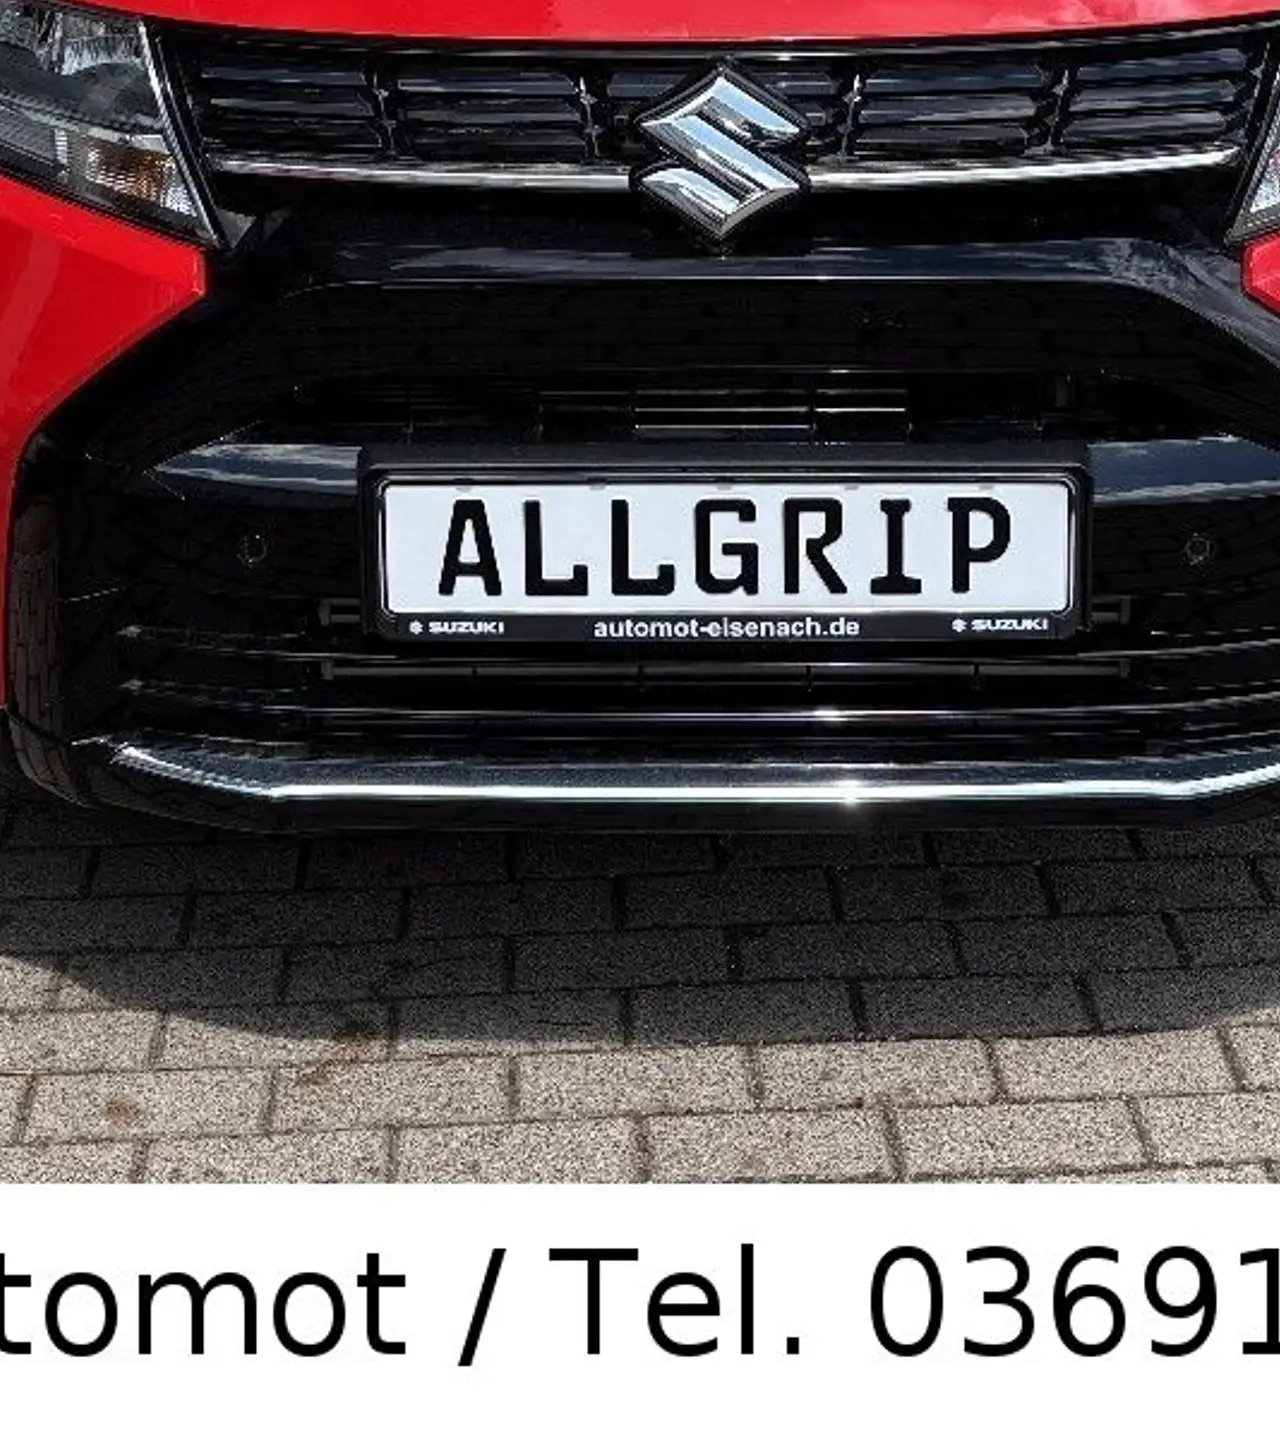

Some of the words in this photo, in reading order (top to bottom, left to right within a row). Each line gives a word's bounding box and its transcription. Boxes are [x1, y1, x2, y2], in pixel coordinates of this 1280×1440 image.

[438, 497, 1011, 597] ALLGRIP
[429, 621, 505, 635] SUZUKI
[593, 616, 860, 638] automot-eisenach.de
[971, 618, 1049, 632] SUZUKI
